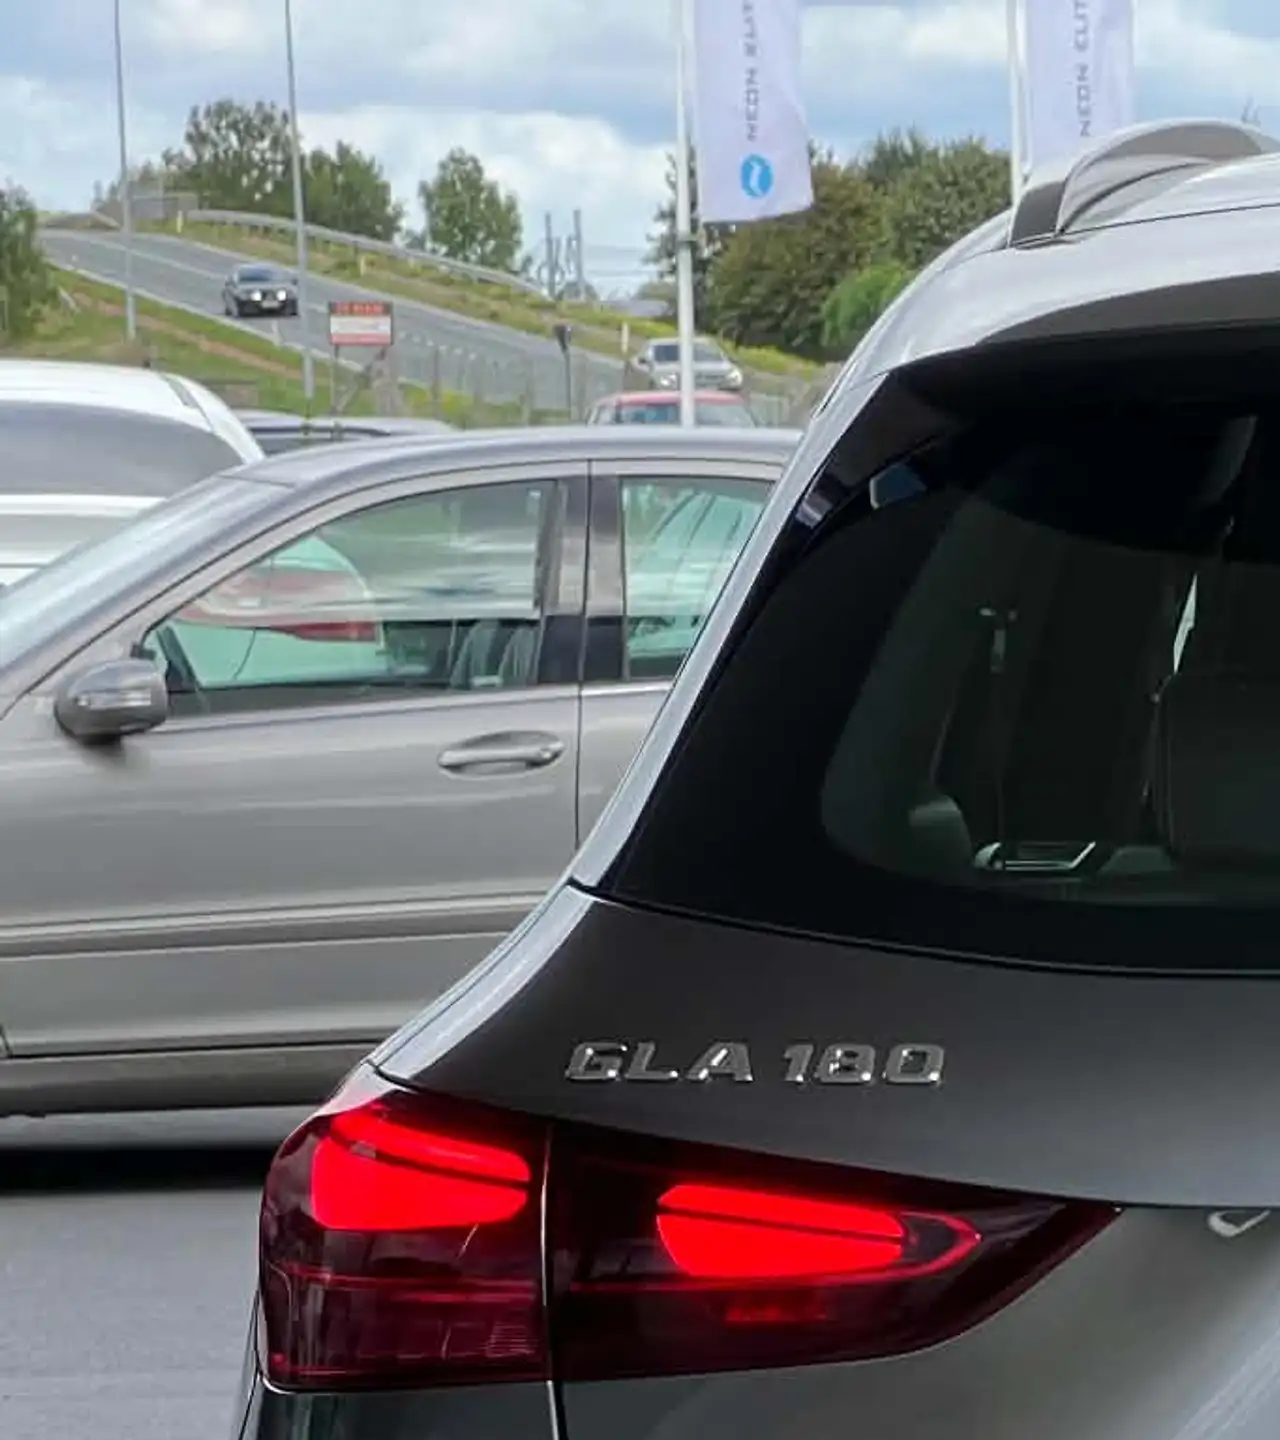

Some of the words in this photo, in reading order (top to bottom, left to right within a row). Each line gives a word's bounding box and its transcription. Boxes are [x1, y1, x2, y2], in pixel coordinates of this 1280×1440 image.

[745, 66, 760, 142] NEON
[1076, 62, 1091, 138] NEON
[565, 1041, 753, 1083] GLA
[782, 1041, 946, 1083] 180
